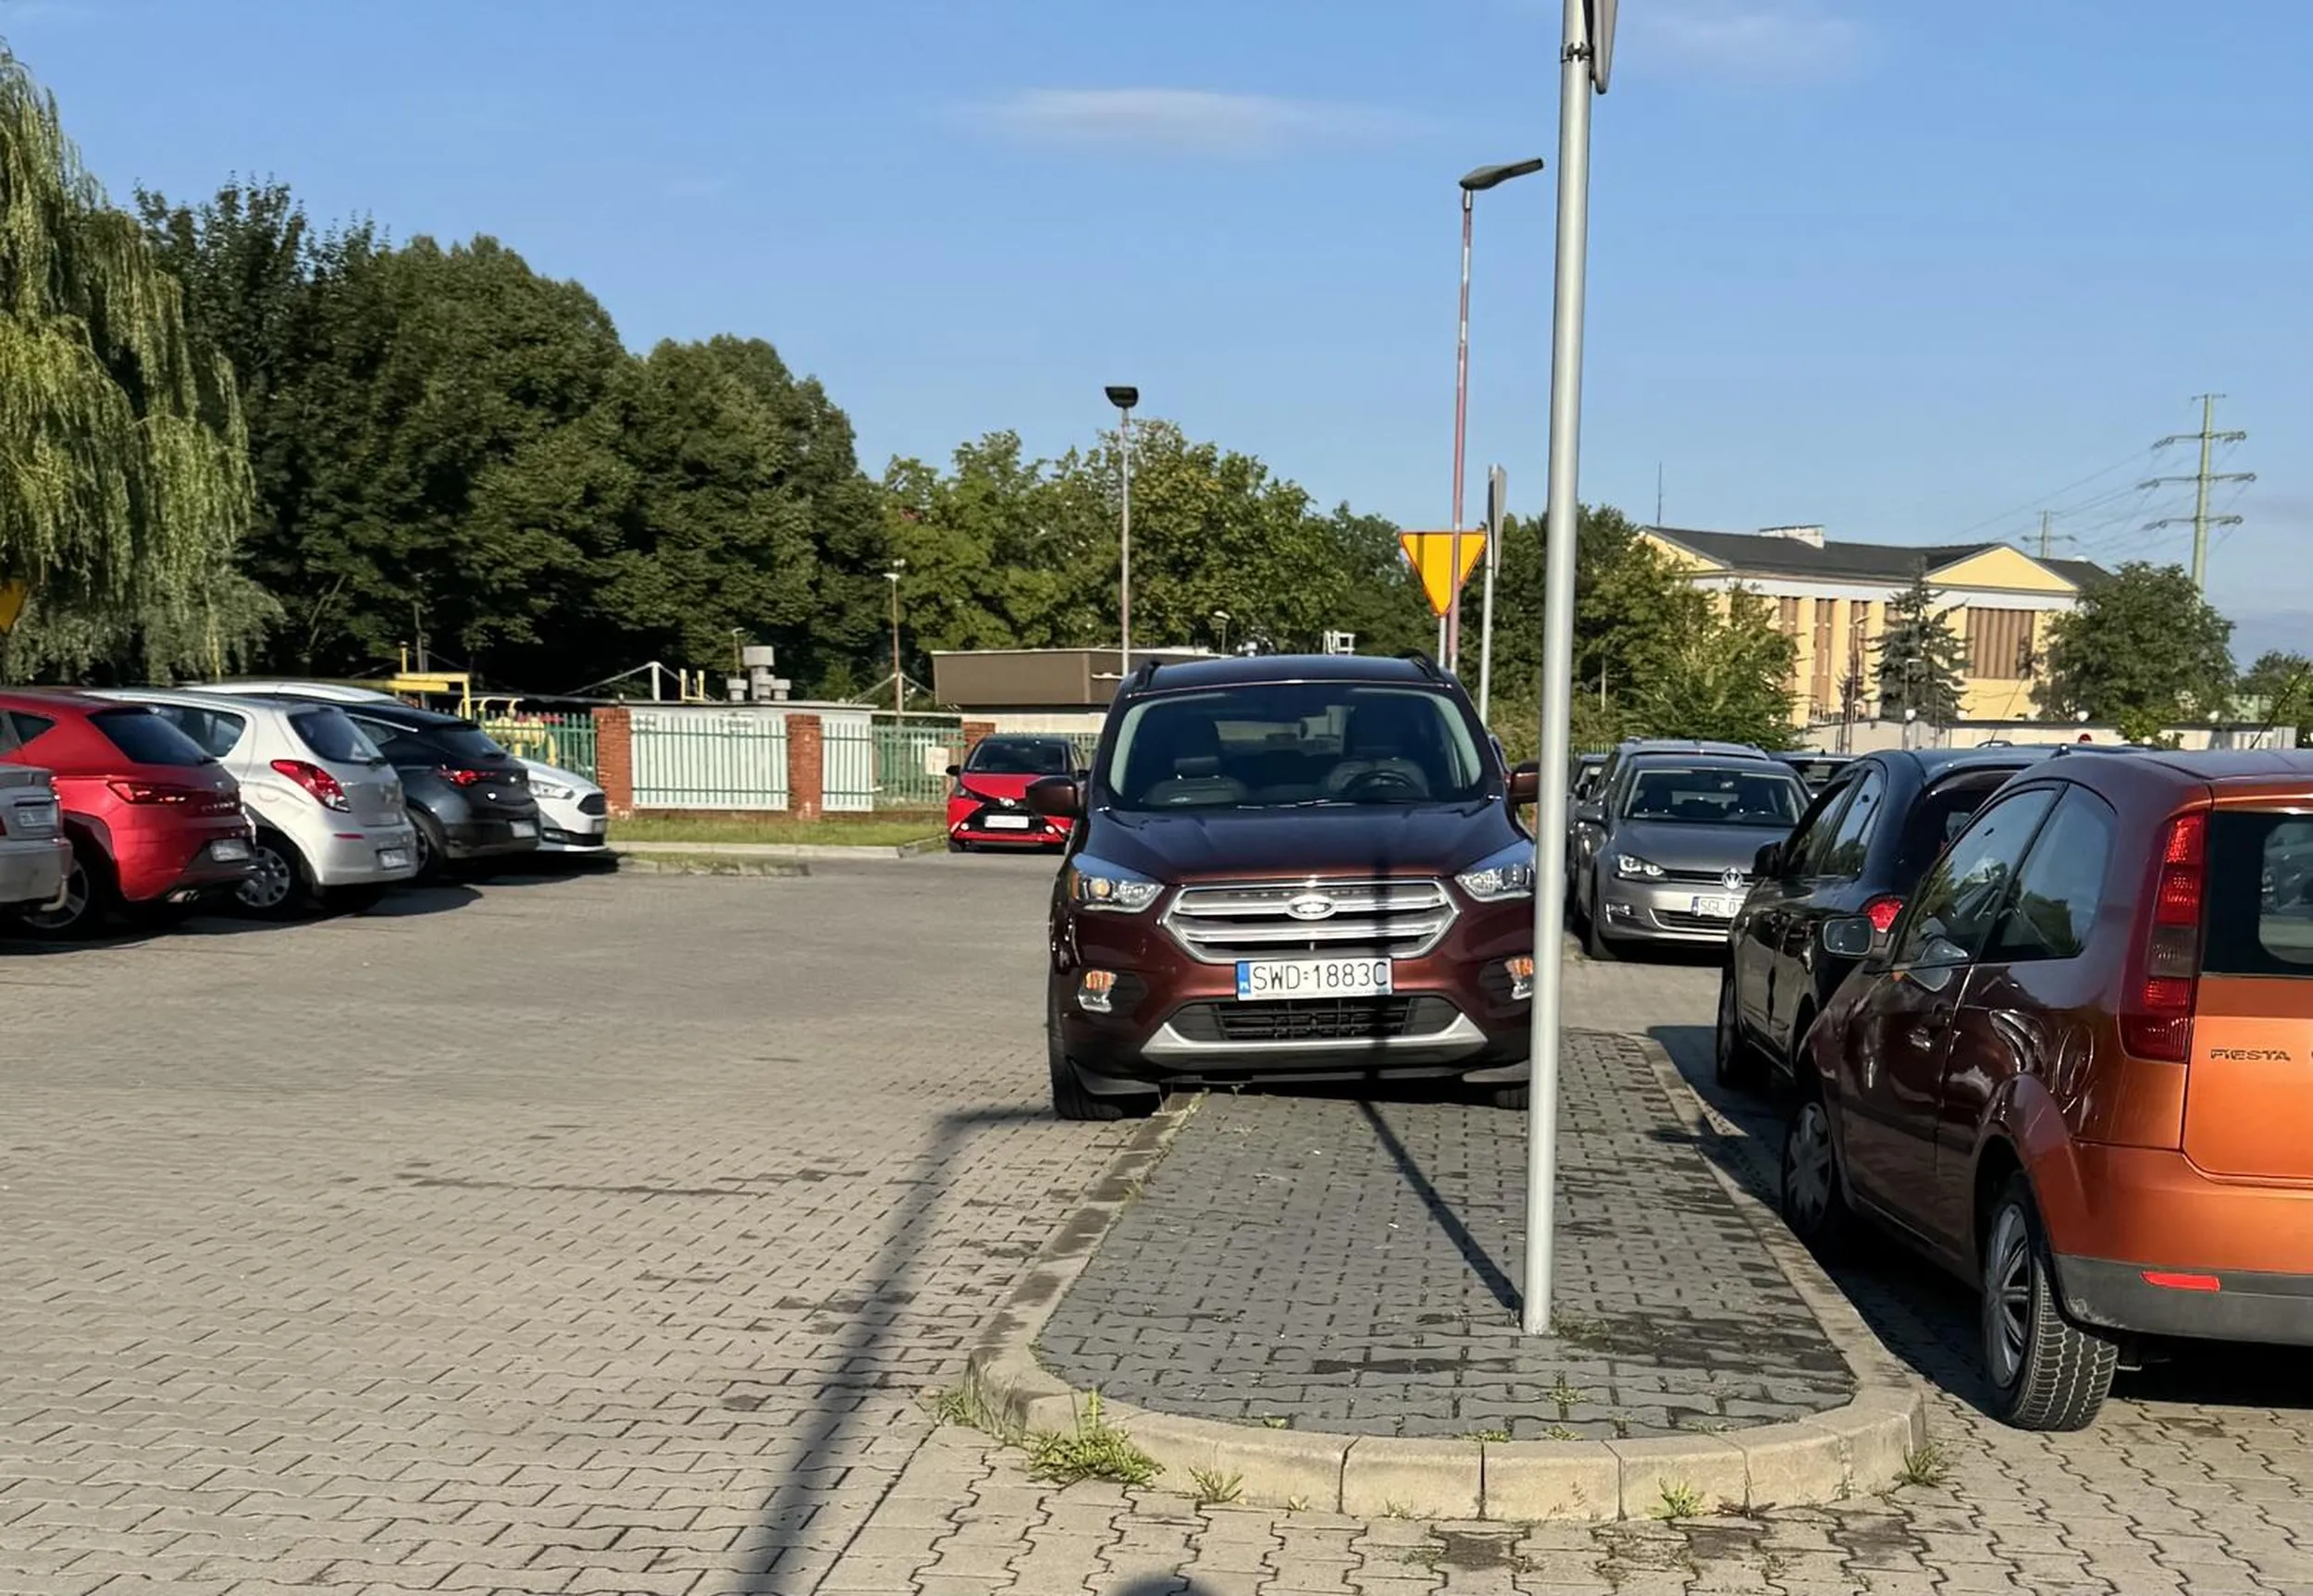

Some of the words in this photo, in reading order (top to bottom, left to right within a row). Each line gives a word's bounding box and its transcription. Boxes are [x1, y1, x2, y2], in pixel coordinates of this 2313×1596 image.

[1253, 965, 1301, 991] SWD
[1313, 961, 1388, 989] 1883C
[2210, 1048, 2291, 1061] FIESTA
